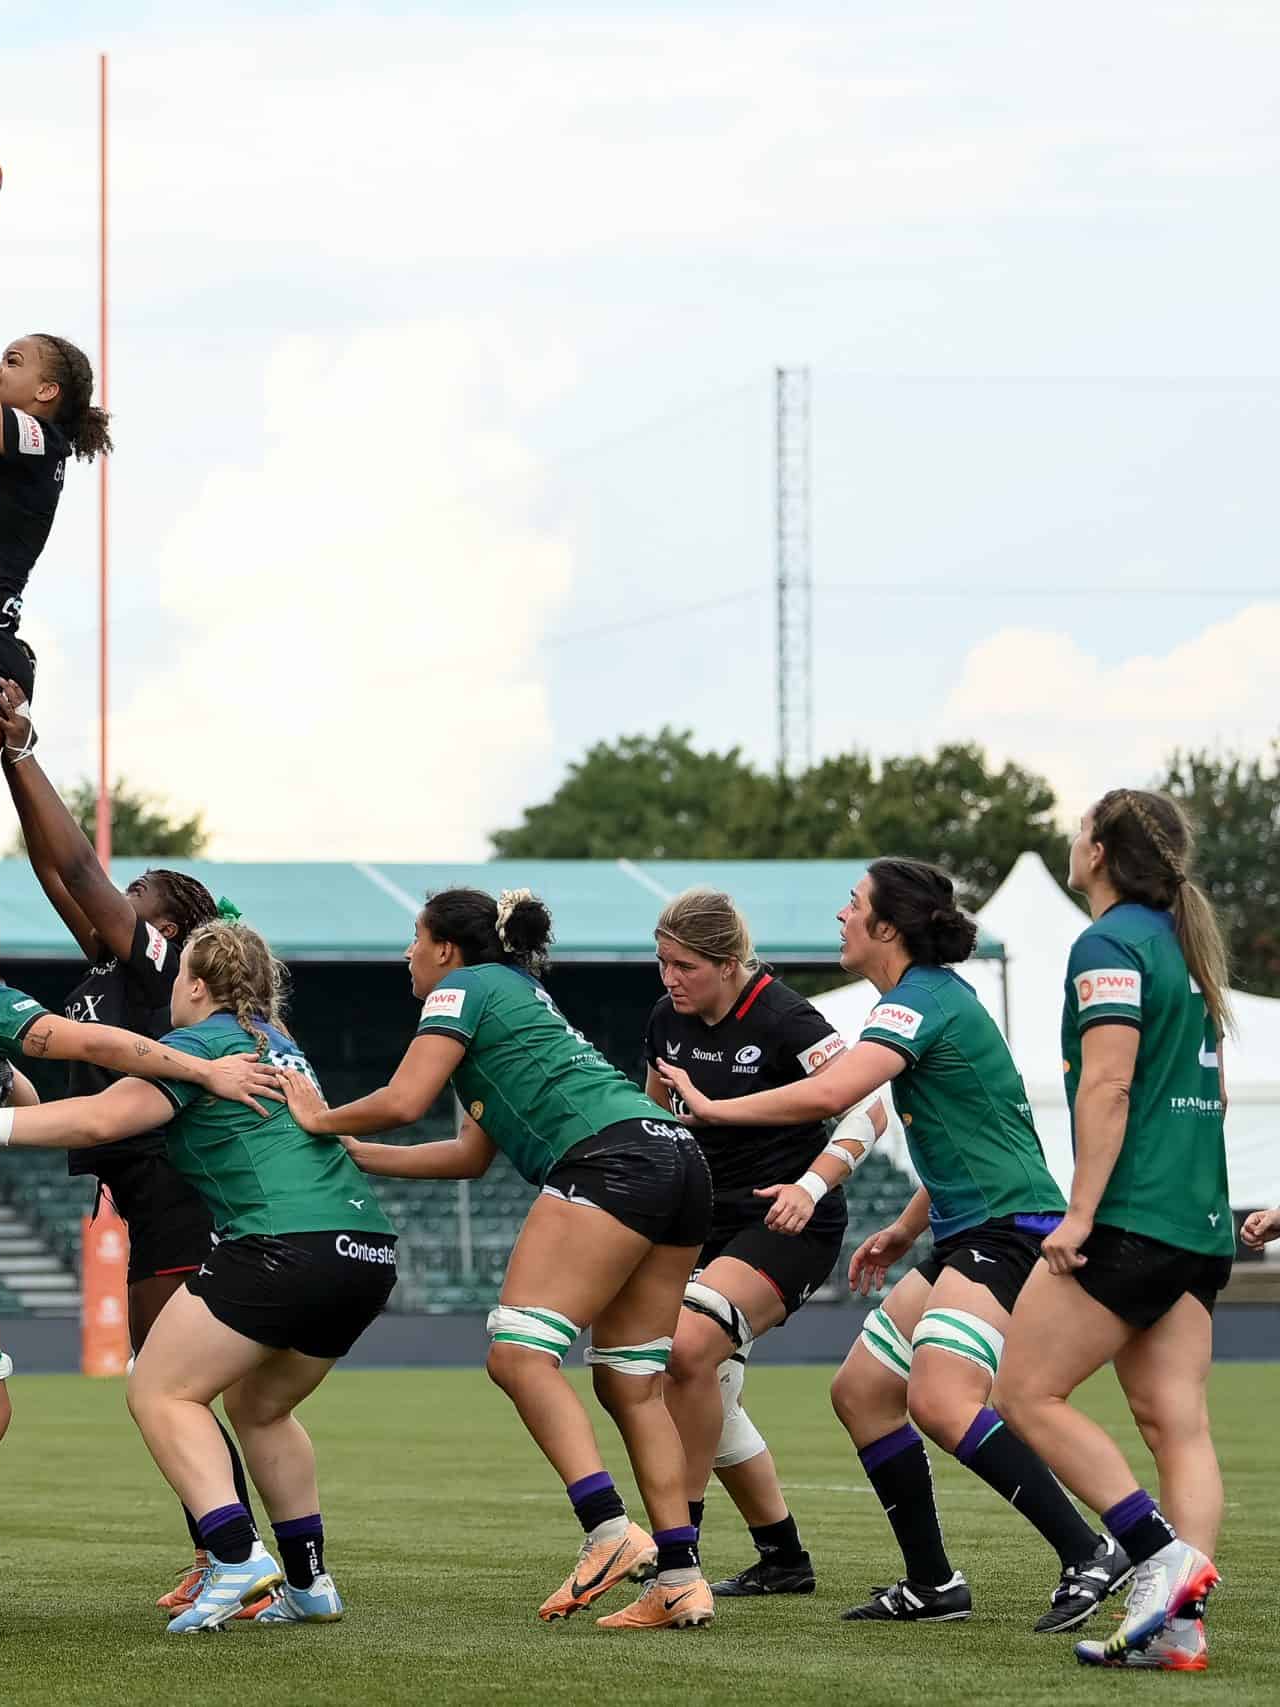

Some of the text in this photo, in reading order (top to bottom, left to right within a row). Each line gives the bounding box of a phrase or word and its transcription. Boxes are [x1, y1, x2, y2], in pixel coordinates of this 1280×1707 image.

[1097, 976, 1136, 989] PWR
[880, 1008, 915, 1025] PWR
[691, 1047, 724, 1063] StoneX
